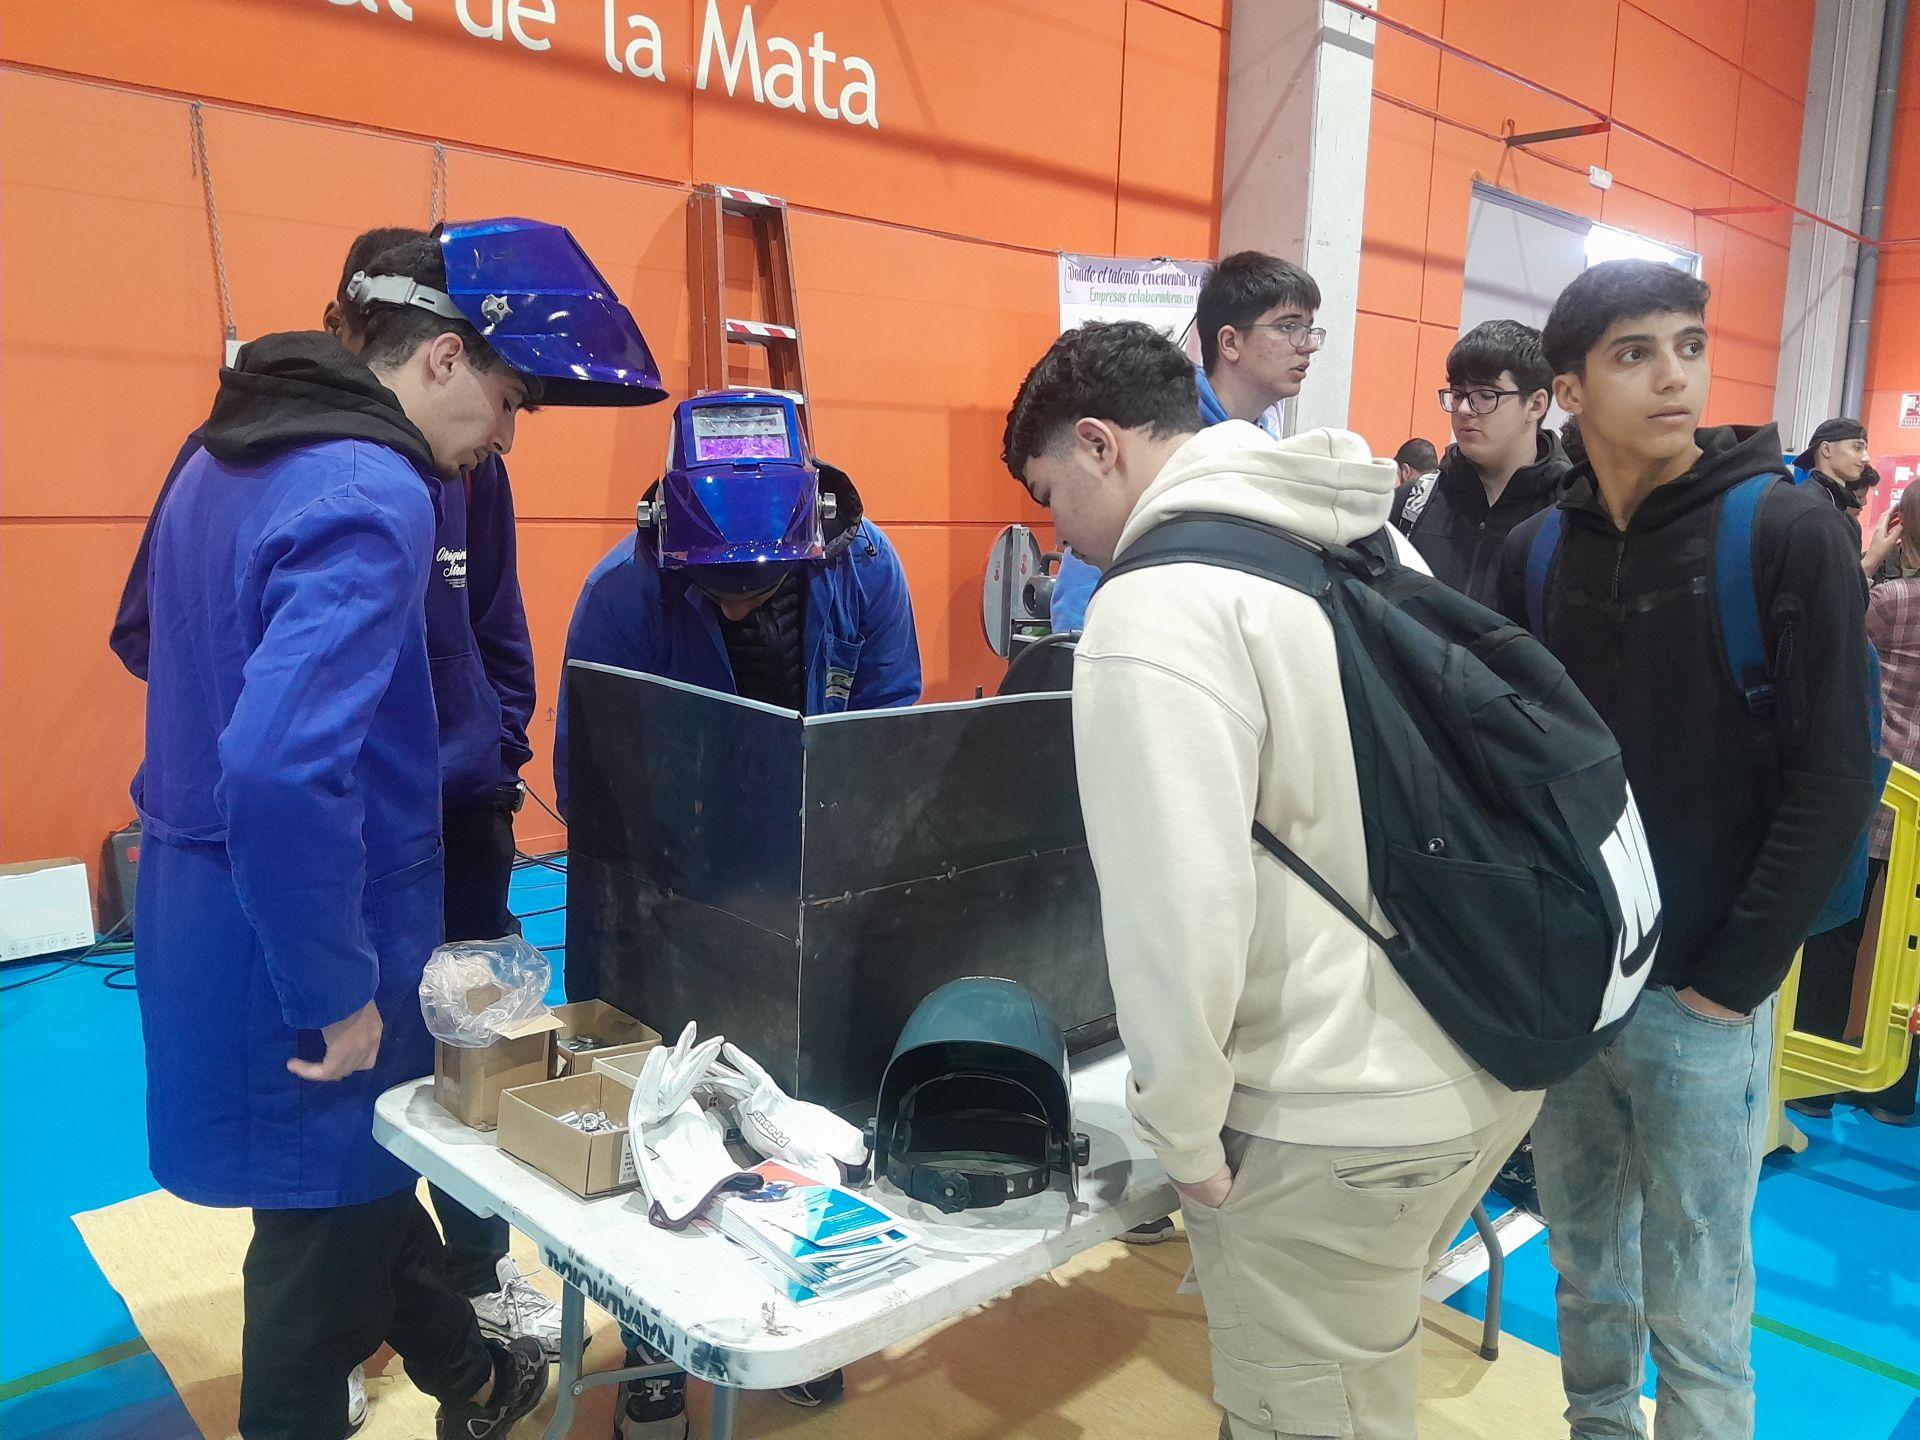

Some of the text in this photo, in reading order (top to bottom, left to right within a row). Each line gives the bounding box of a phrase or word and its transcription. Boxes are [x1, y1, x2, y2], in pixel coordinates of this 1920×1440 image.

[604, 0, 666, 84] la
[696, 0, 879, 130] Mata
[1097, 266, 1108, 284] el
[1108, 266, 1140, 285] talento
[1089, 287, 1126, 306] Empresas
